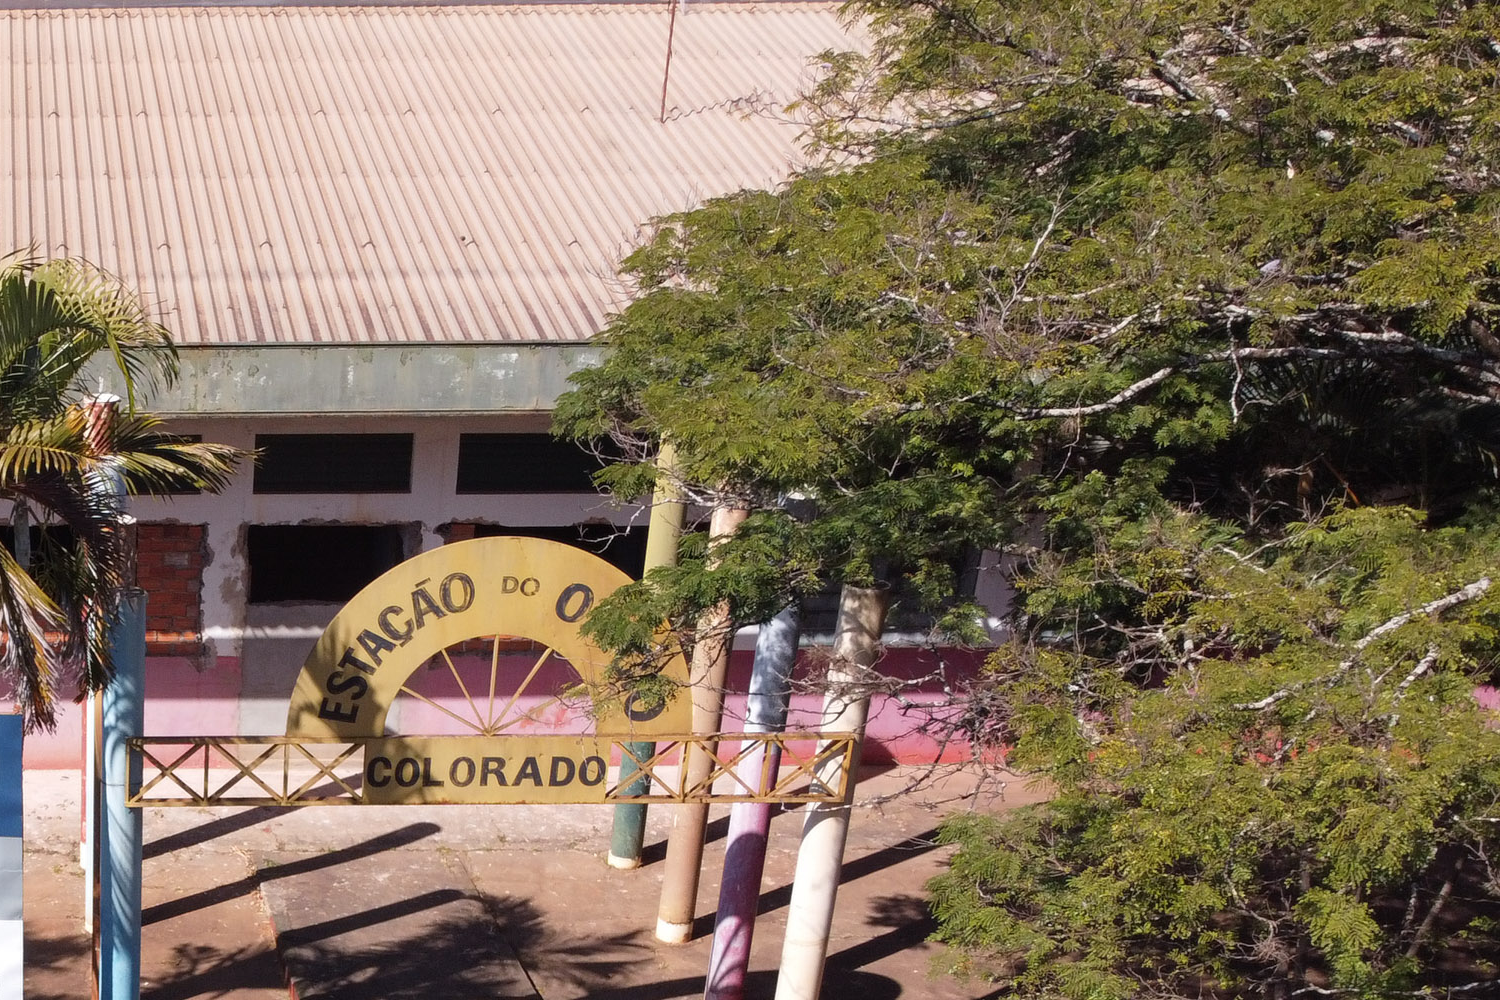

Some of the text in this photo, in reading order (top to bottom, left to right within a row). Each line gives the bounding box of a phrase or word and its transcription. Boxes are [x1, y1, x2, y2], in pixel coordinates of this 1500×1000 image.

[318, 572, 476, 724] ESTAÇÃO
[501, 575, 541, 596] DO
[366, 755, 608, 788] COLORADO
